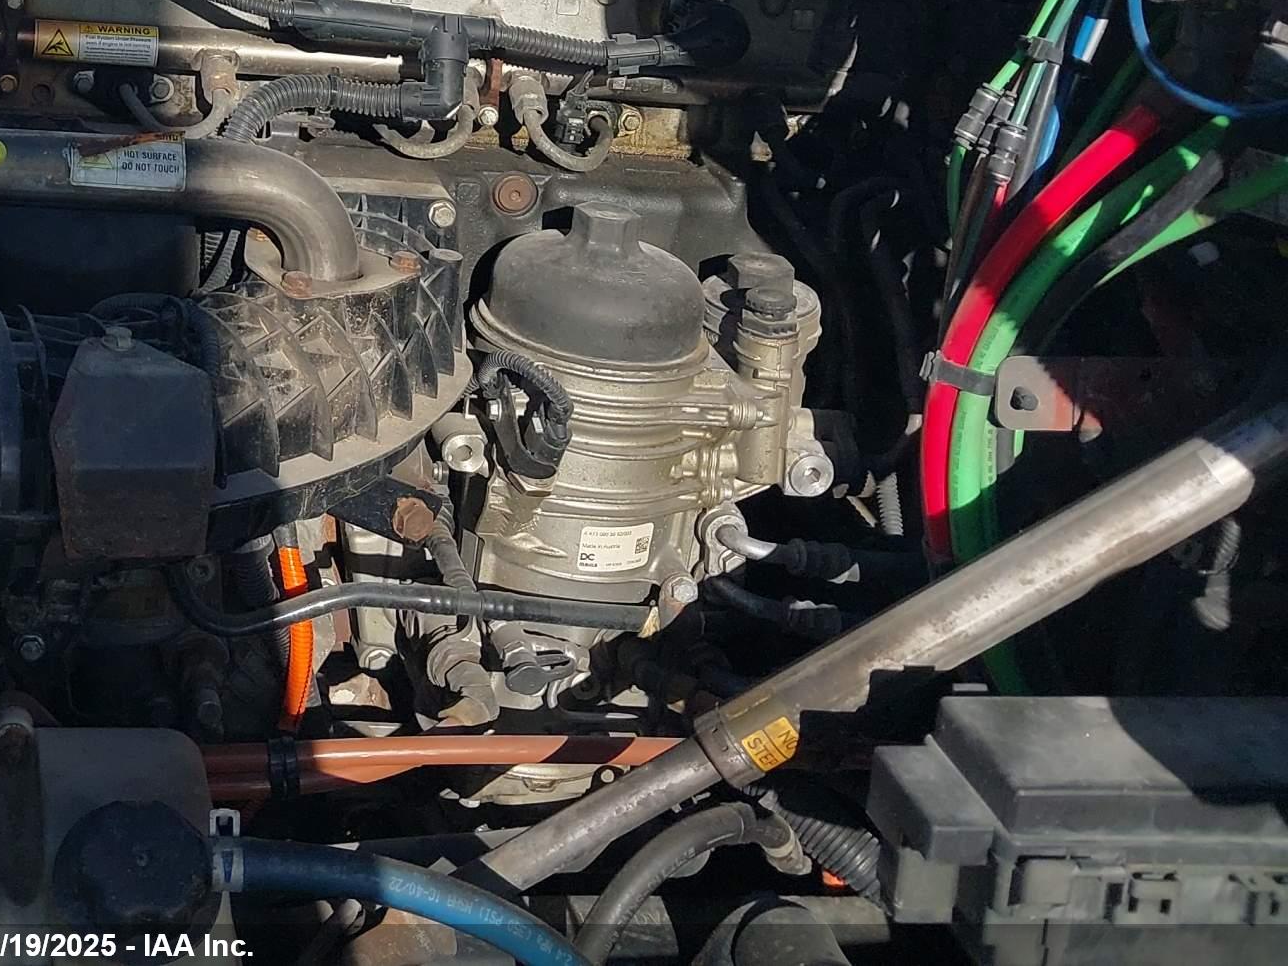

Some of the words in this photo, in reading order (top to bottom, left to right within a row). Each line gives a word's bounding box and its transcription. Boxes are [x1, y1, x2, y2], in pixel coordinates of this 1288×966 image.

[97, 24, 151, 35] WARNING
[123, 149, 139, 159] HOT
[142, 151, 177, 161] SURFACE
[122, 161, 133, 171] DO
[135, 162, 151, 172] NOT
[154, 164, 180, 174] TOUCH
[579, 552, 596, 561] DC
